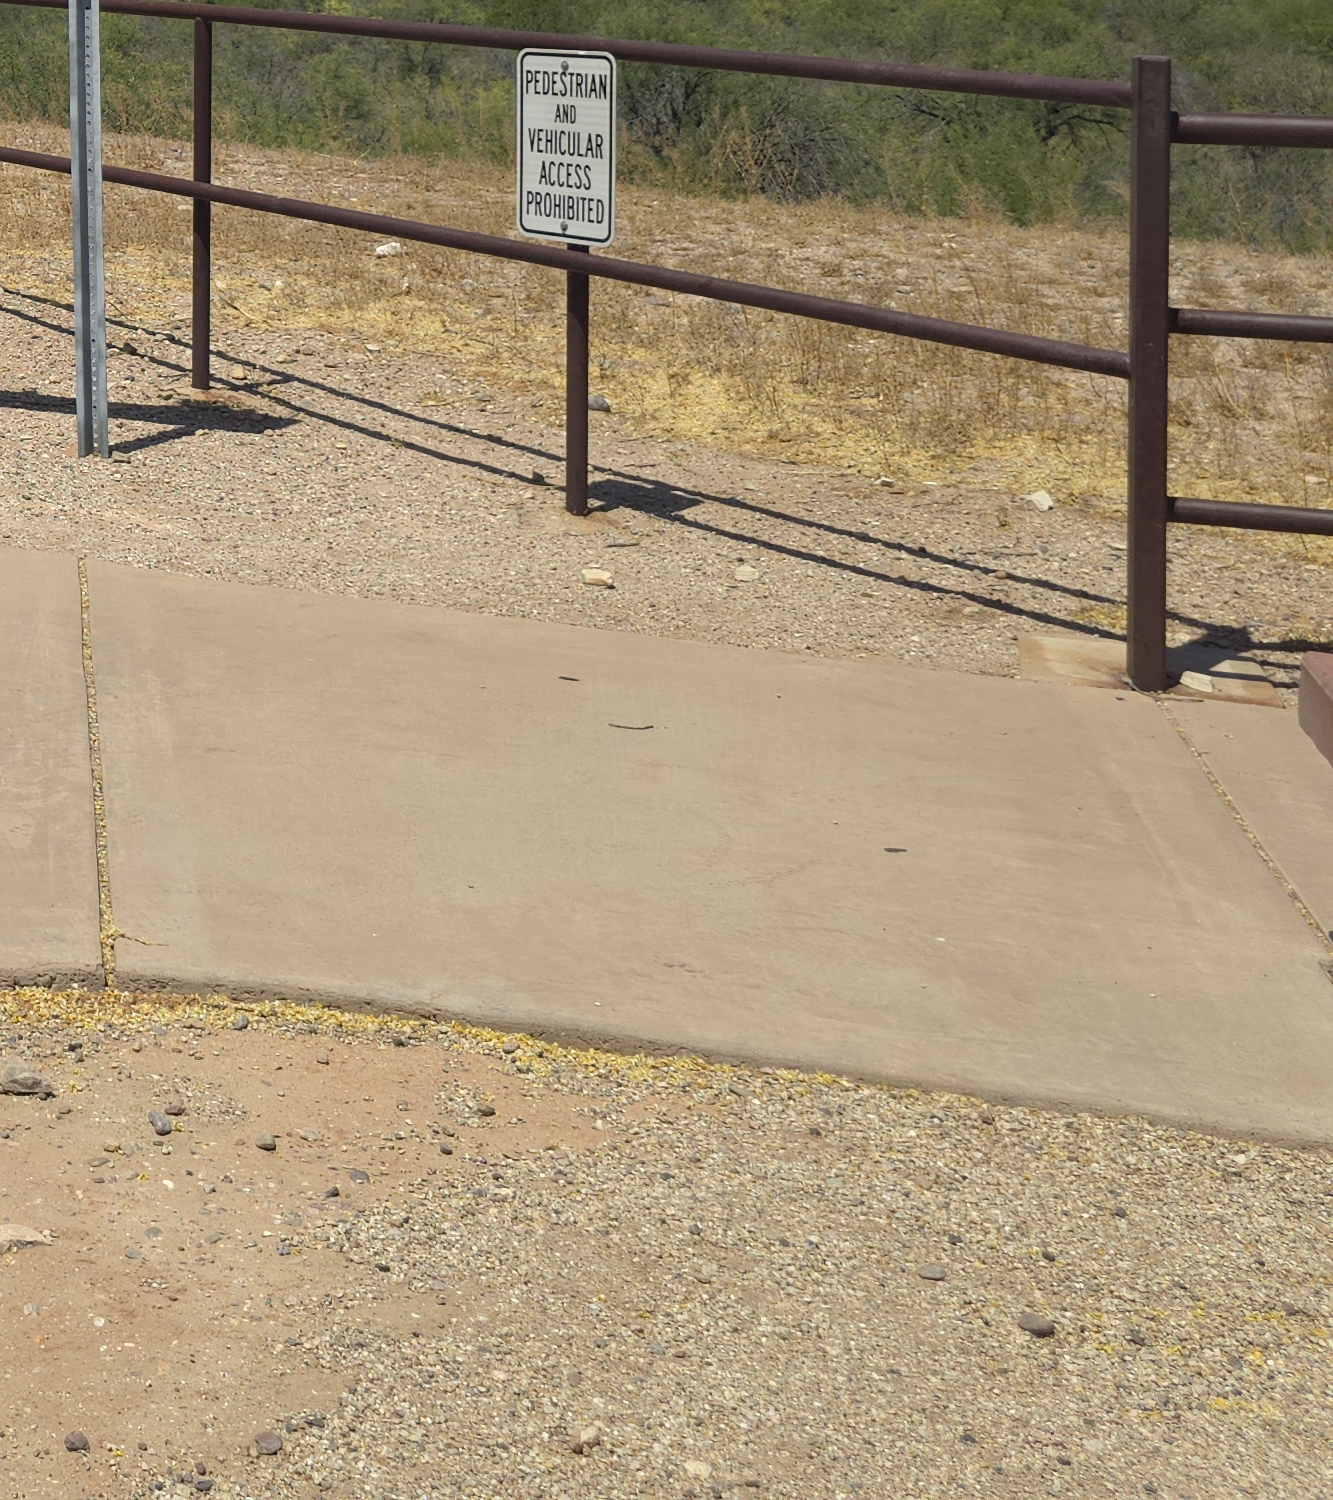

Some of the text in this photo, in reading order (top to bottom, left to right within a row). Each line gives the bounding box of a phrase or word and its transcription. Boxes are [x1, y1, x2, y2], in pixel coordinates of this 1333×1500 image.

[525, 69, 608, 100] PEDESTRIAN
[554, 103, 577, 124] AND
[528, 127, 604, 160] VEHICULAR
[538, 160, 592, 191] ACCESS
[526, 190, 605, 225] PROHIBITED
